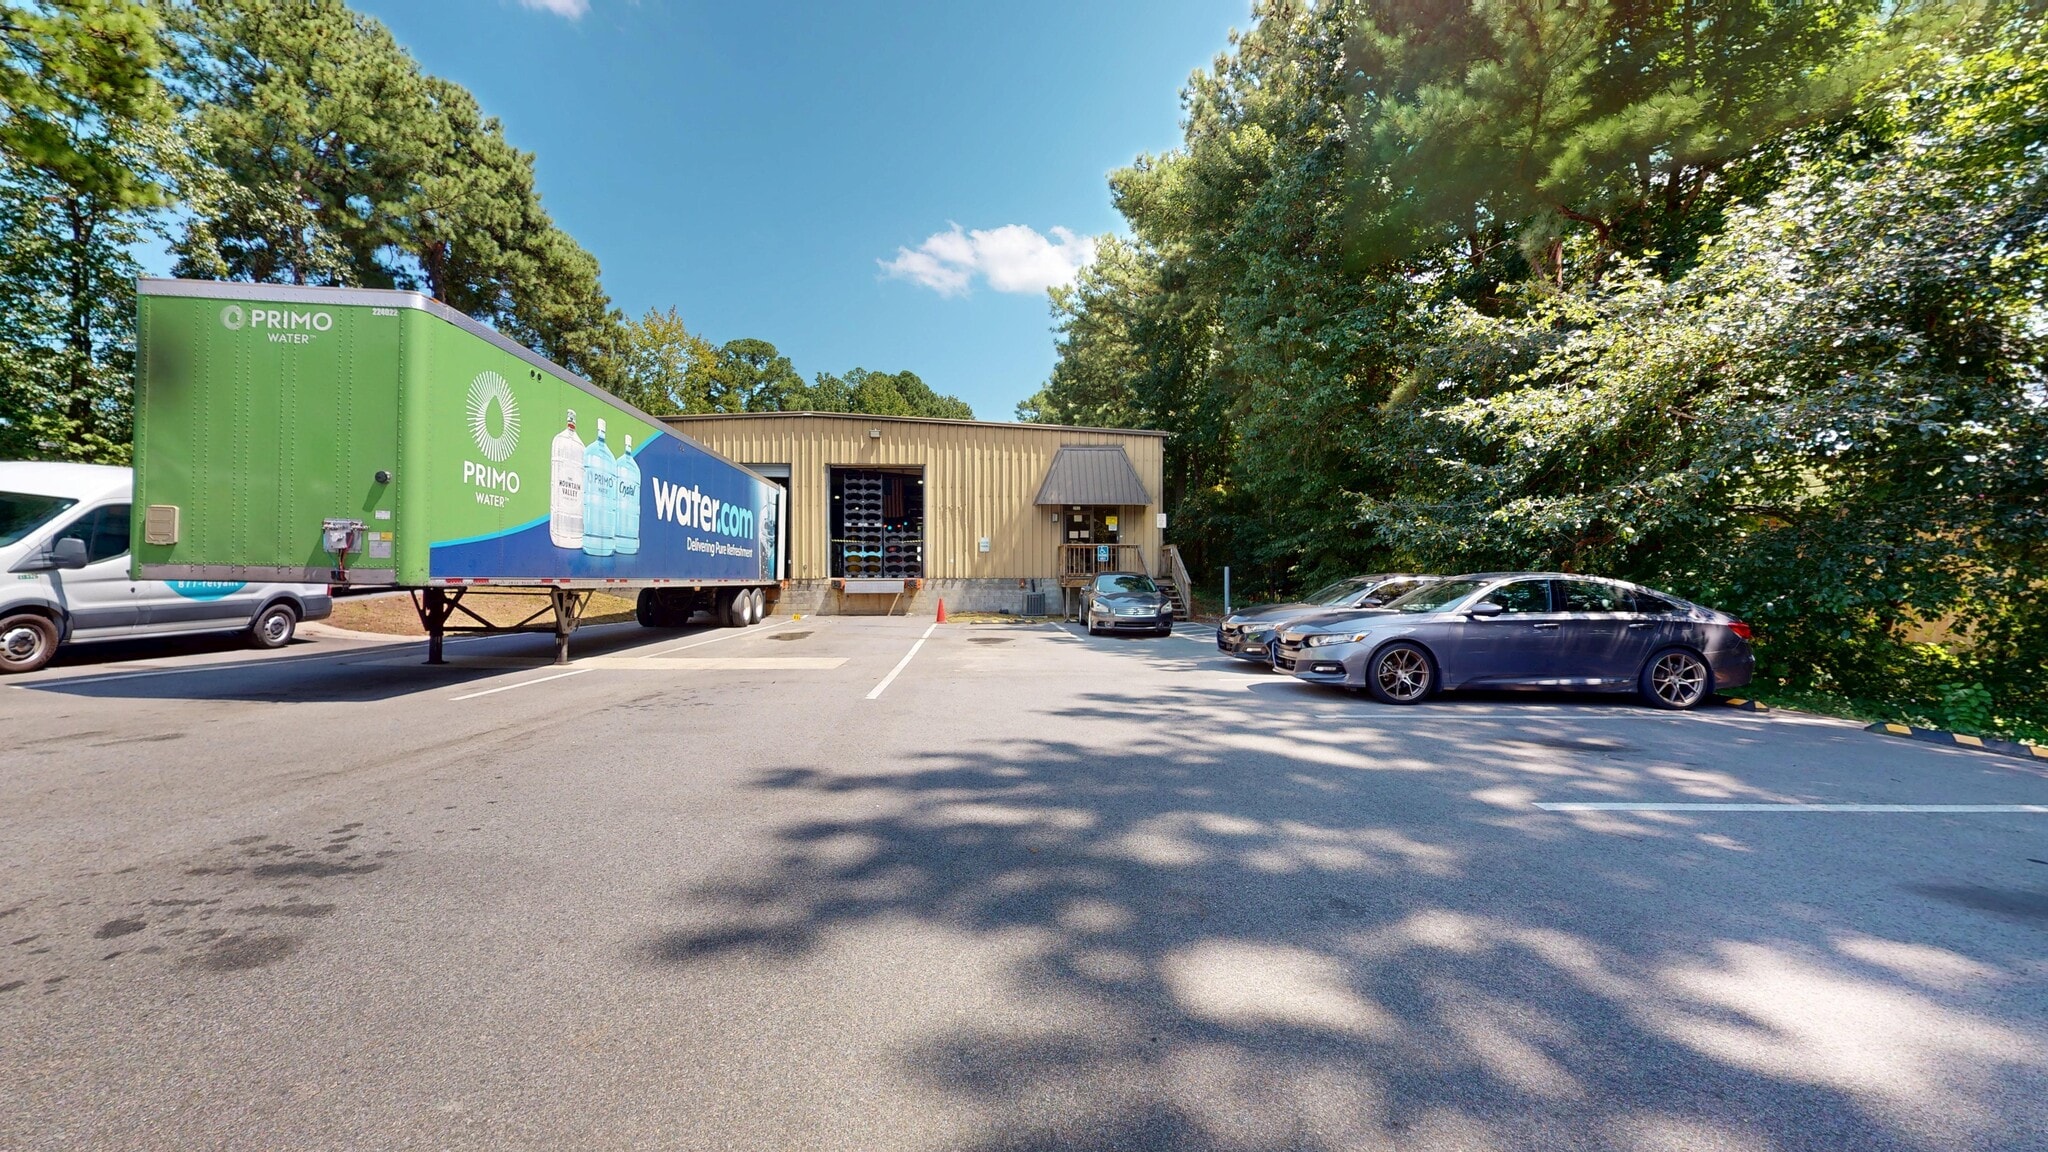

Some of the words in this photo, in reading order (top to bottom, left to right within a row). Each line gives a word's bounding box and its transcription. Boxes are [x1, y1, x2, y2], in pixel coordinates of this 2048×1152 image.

[251, 309, 333, 331] PRIMO
[463, 460, 520, 494] PRIMO
[559, 479, 581, 491] MOUNTAIN
[594, 473, 613, 488] PRIMO
[562, 487, 578, 498] VALLEY
[618, 481, 636, 498] Crystal
[652, 476, 754, 540] water.com
[686, 536, 715, 557] Delivering
[715, 541, 727, 555] Pure
[726, 543, 753, 558] Refreshment
